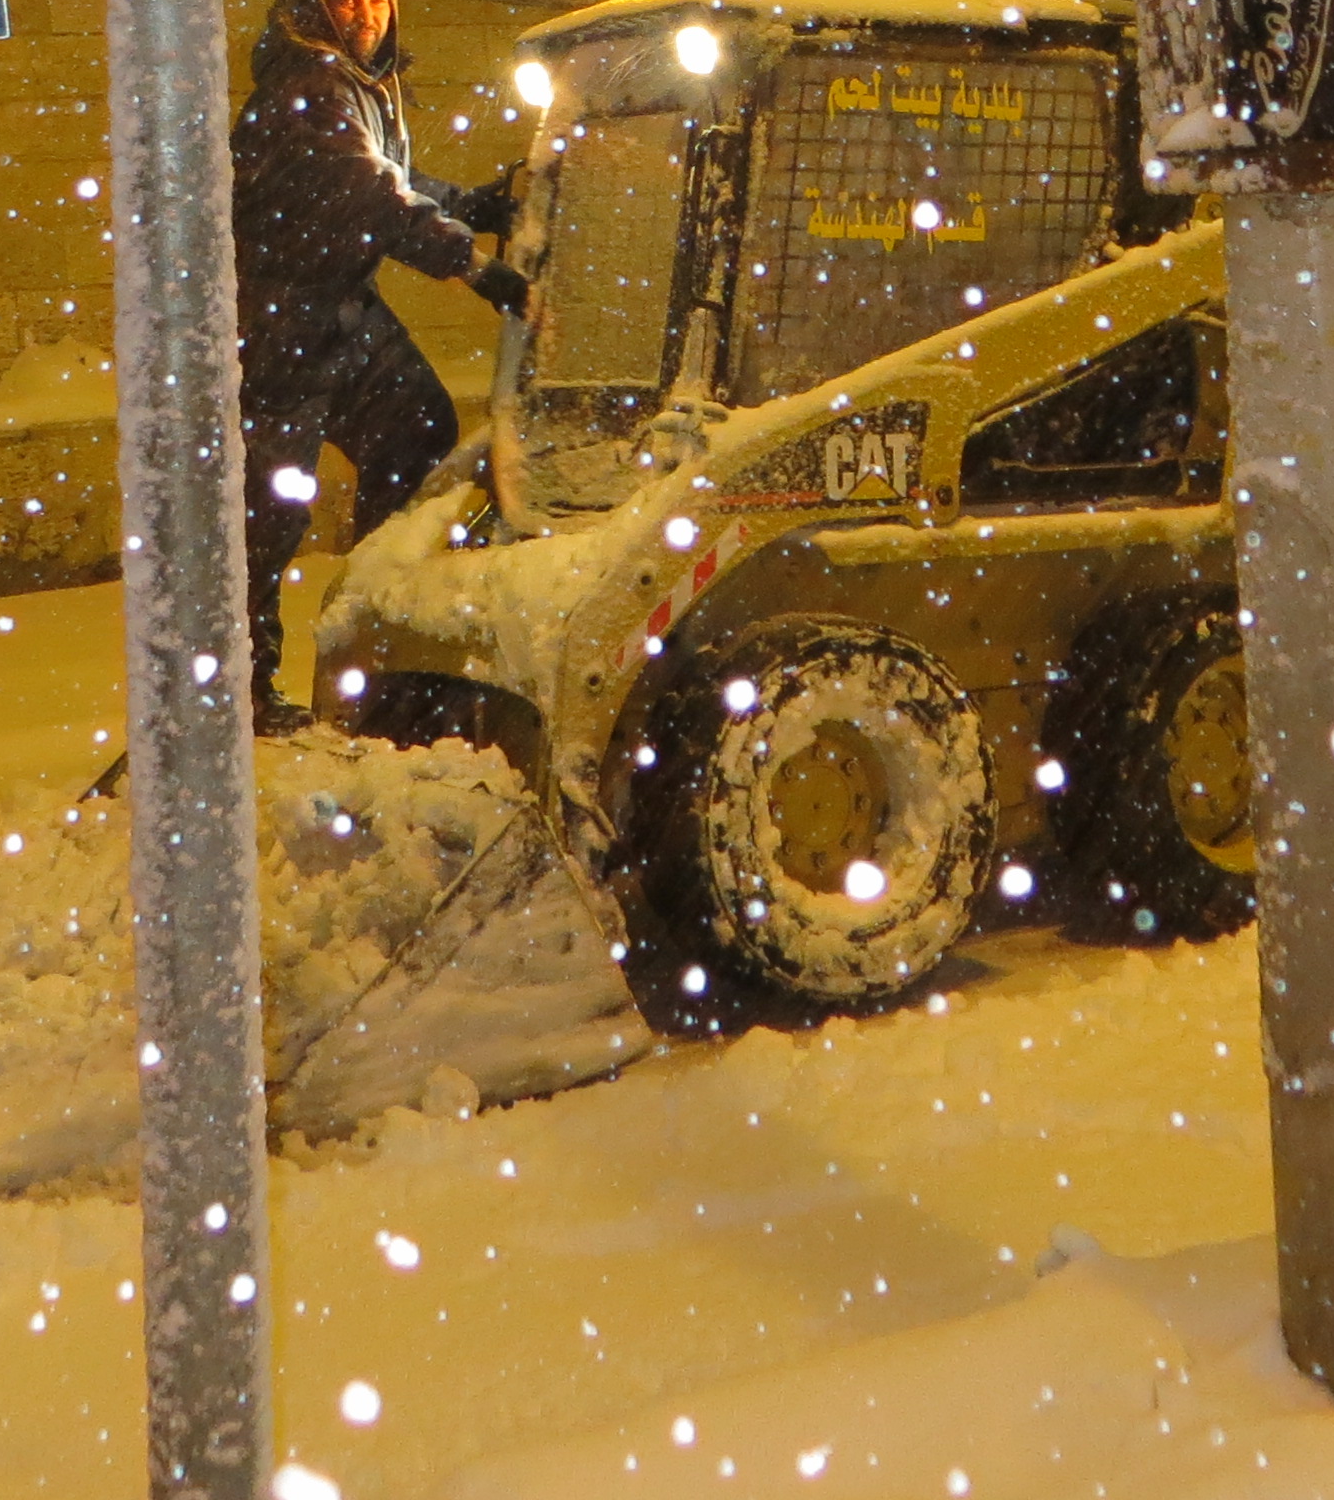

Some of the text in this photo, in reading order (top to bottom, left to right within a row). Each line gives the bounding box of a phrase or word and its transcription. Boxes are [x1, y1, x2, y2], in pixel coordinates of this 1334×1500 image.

[828, 65, 1024, 137] بلدية بيت لحم
[825, 432, 914, 500] CAT
